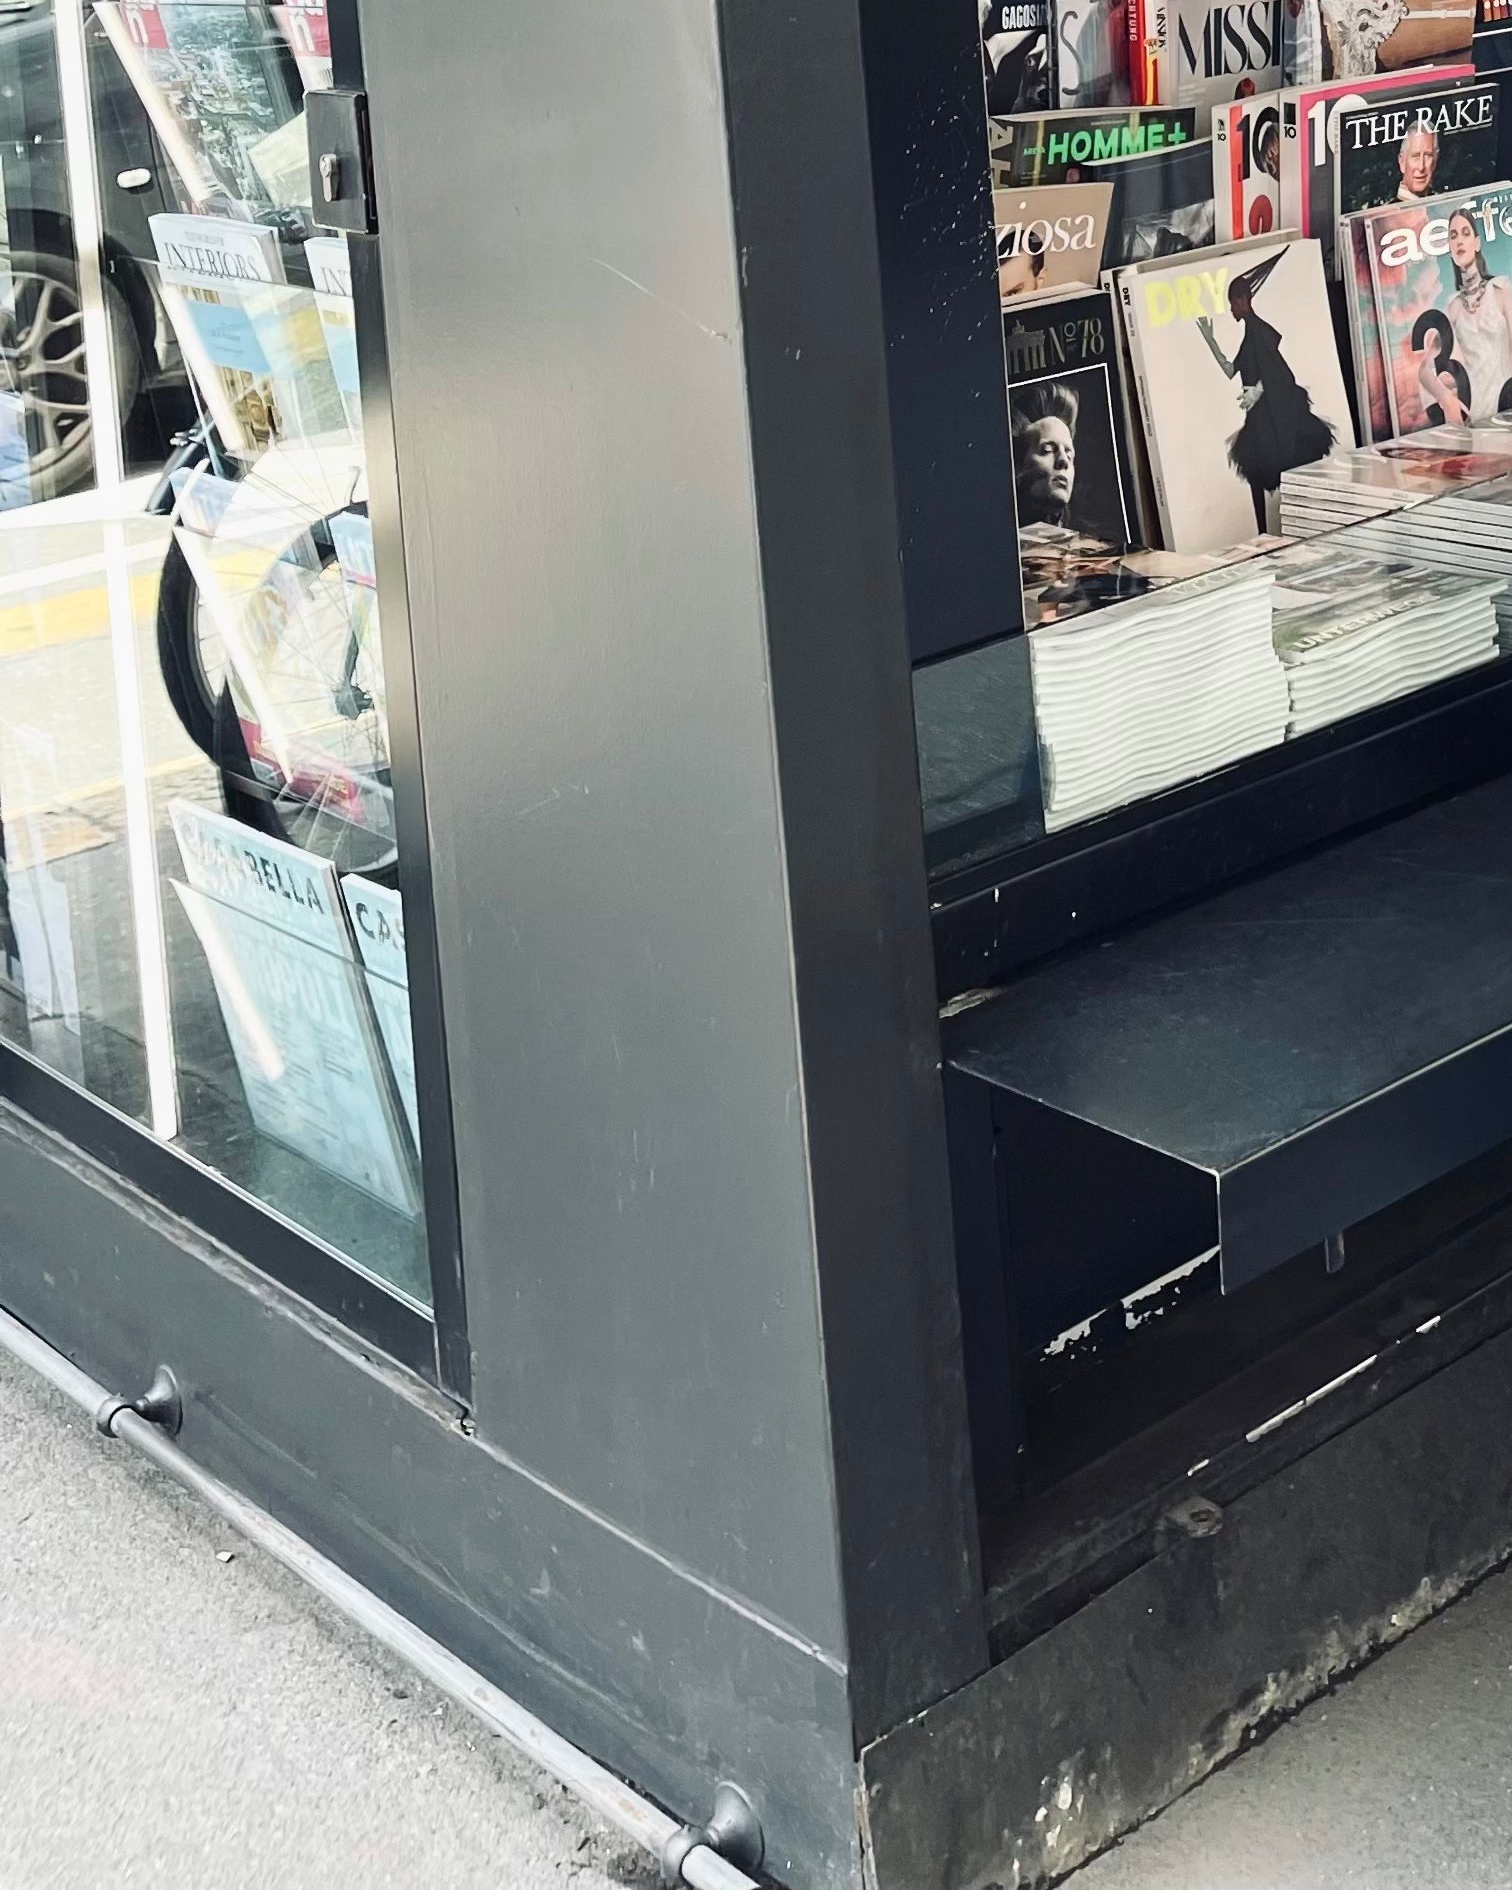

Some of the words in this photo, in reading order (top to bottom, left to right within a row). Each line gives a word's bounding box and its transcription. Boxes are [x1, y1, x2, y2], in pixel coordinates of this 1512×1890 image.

[1217, 132, 1227, 142] 10
[1284, 125, 1297, 139] 10
[1346, 114, 1408, 150] THE
[1415, 94, 1494, 138] RAKE
[1047, 121, 1187, 165] HOMME+
[163, 241, 263, 282] INTERIORS
[1121, 285, 1132, 307] DRY
[1145, 267, 1228, 329] DRY
